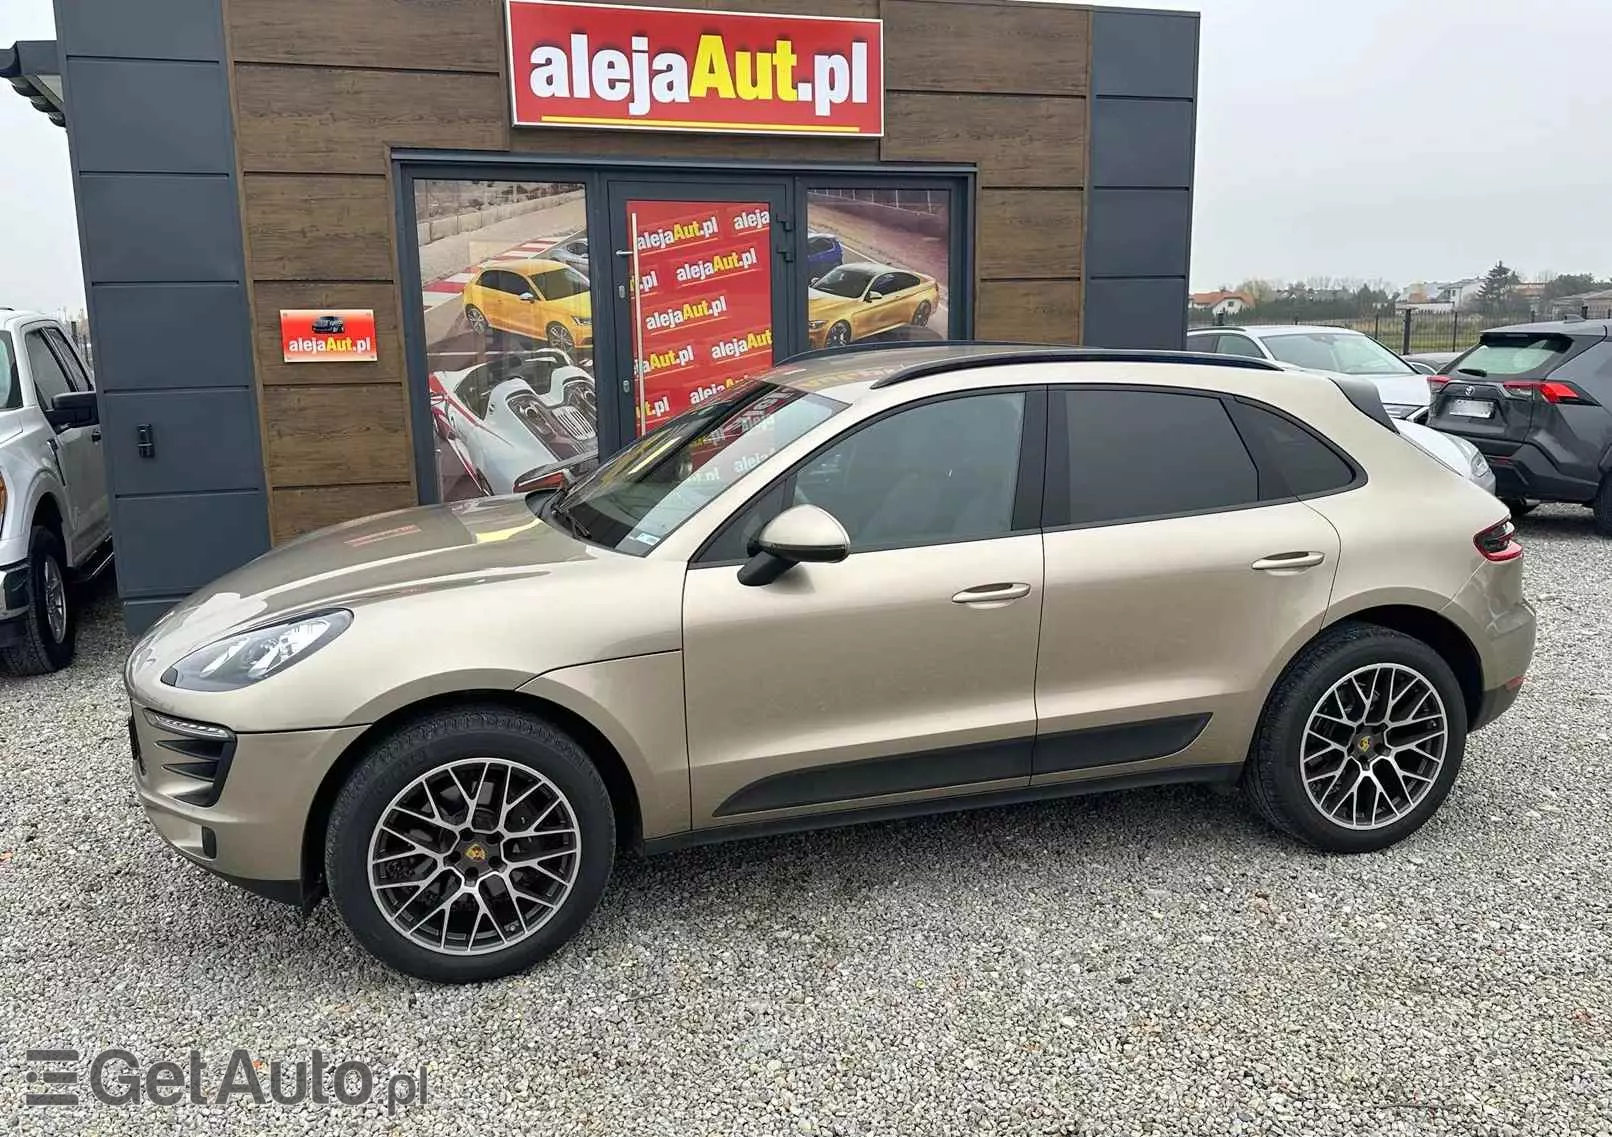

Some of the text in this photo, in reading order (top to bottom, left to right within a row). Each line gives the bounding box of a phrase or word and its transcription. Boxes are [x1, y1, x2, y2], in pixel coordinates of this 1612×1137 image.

[530, 33, 868, 116] alejaAut.pl
[637, 216, 718, 250] alejaAut.pl
[676, 248, 757, 280] alejaAut.pl
[646, 296, 727, 330] alejaAut.pl
[288, 337, 371, 354] alejaAut.pl
